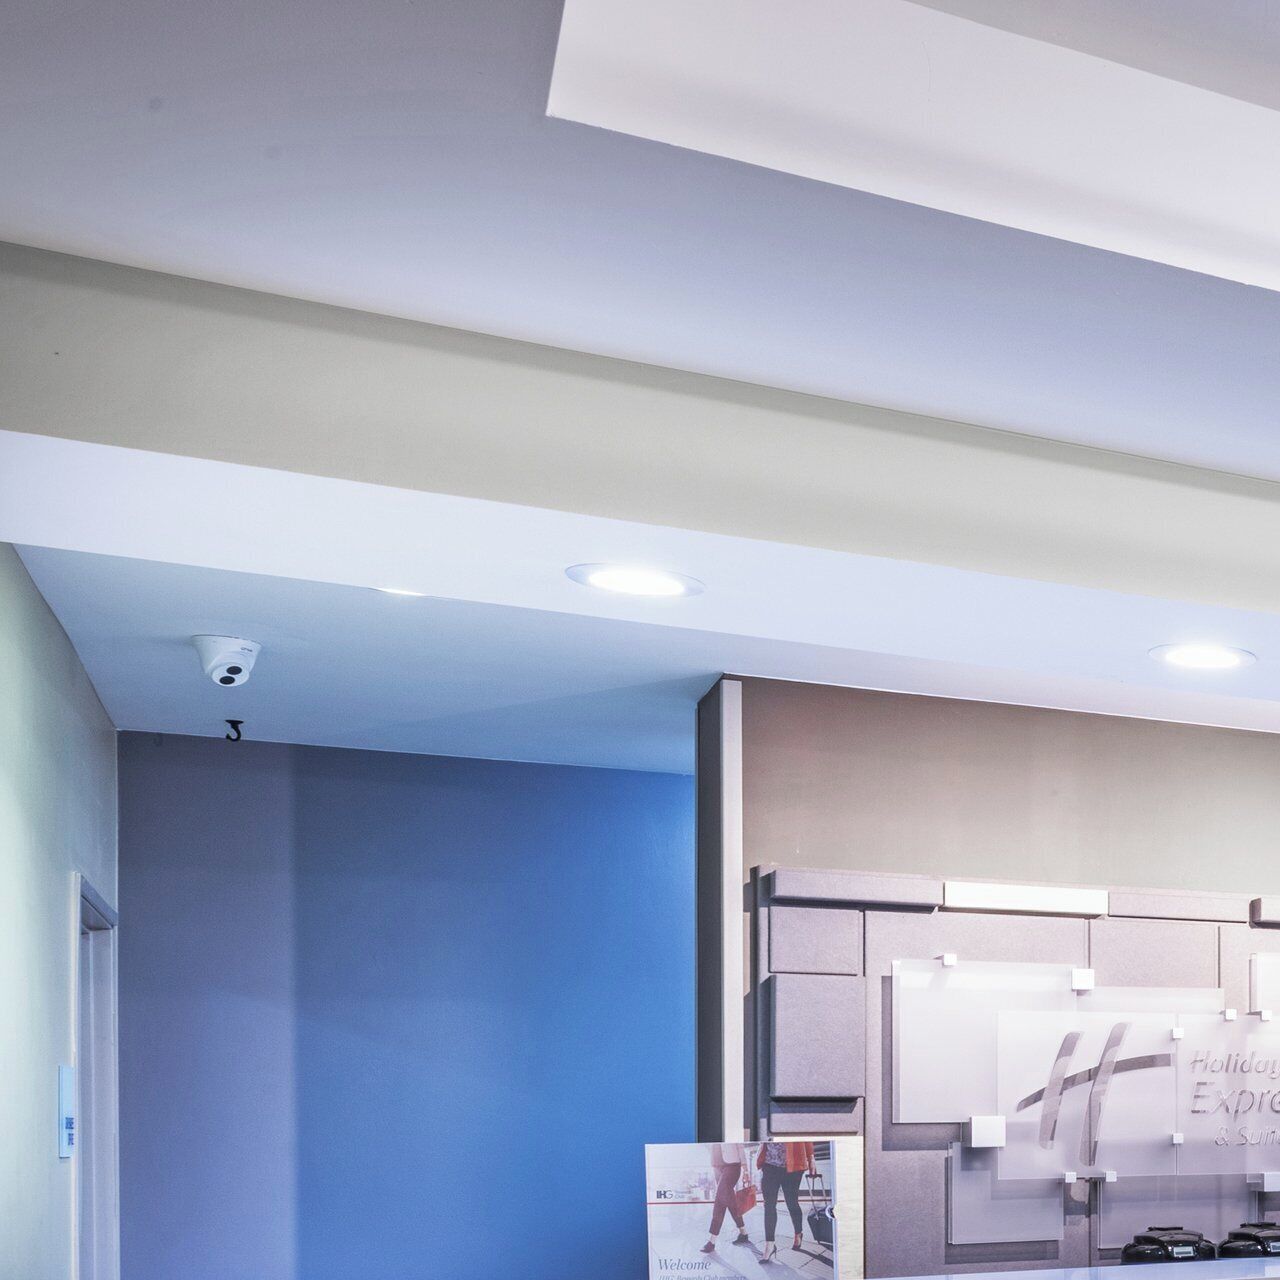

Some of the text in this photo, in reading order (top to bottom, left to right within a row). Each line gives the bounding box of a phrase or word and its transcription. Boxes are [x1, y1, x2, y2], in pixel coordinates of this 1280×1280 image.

[1214, 1126, 1230, 1146] &
[656, 1189, 673, 1199] IHG
[658, 1258, 712, 1272] Welcome
